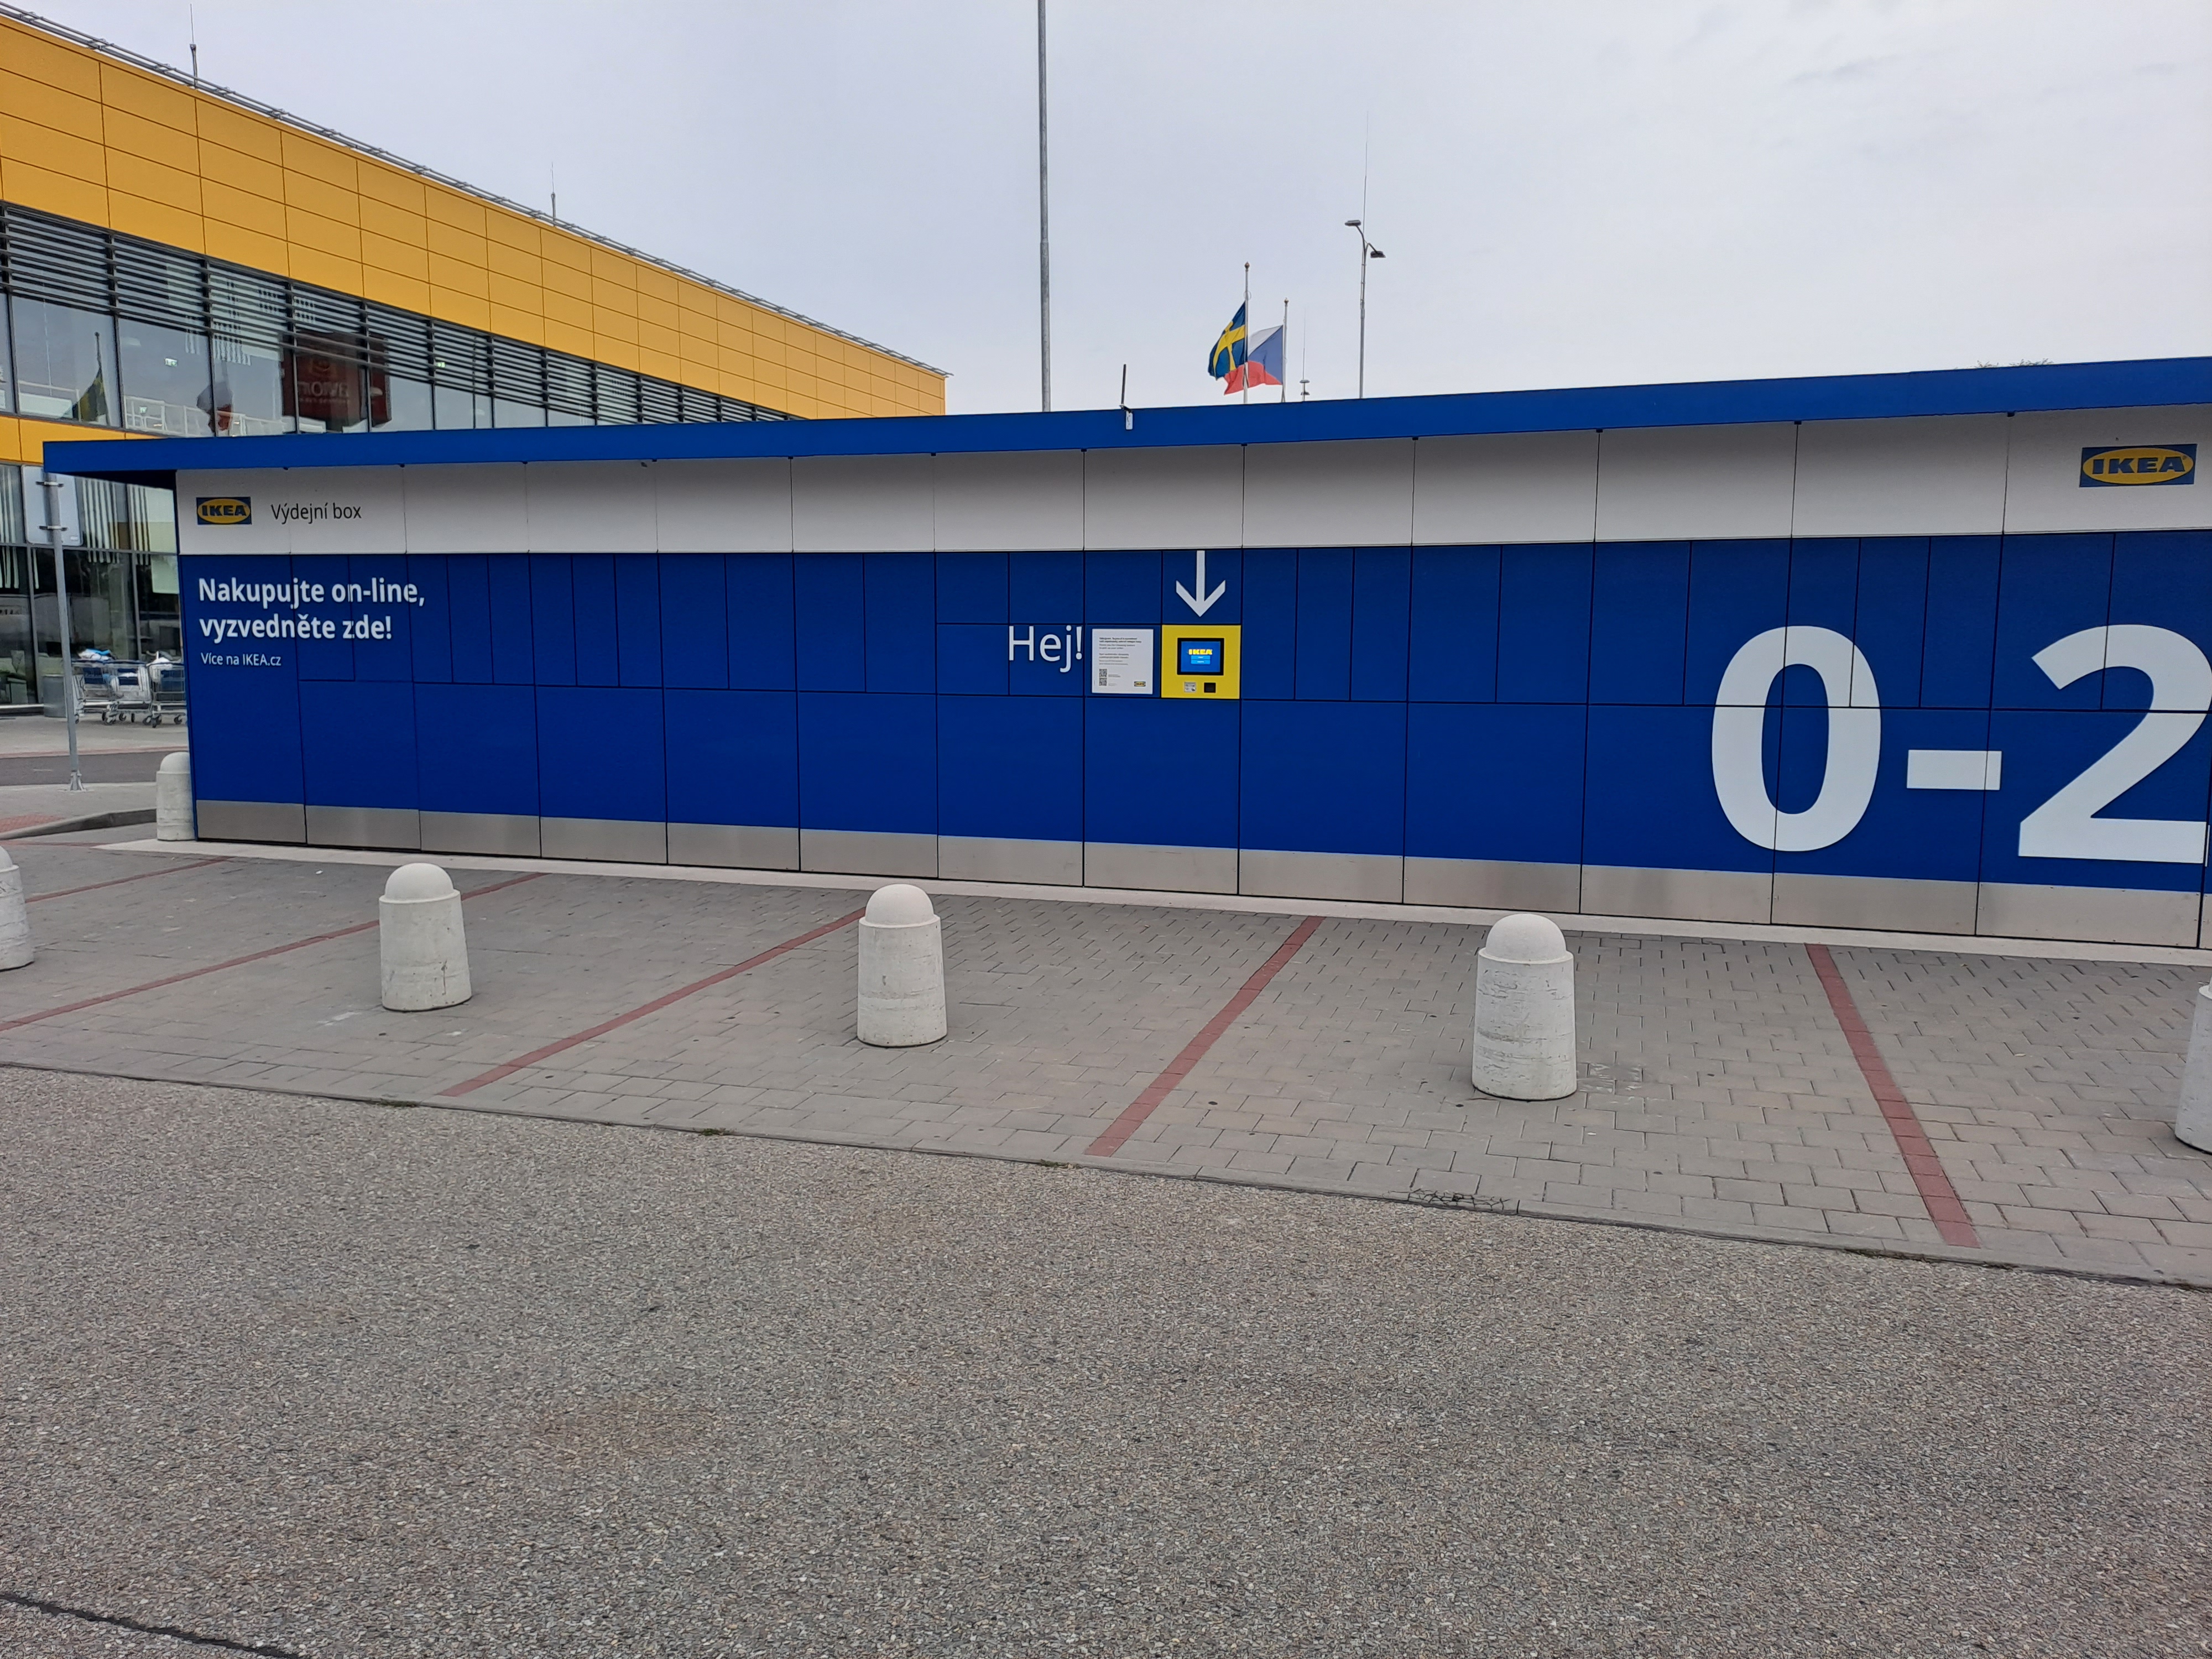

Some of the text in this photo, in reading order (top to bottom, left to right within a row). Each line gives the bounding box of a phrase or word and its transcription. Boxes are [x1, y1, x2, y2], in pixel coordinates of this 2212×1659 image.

[2092, 456, 2185, 474] IKEA
[201, 505, 247, 517] IKEA
[270, 502, 362, 525] Výdejní box
[199, 577, 425, 609] Nakupujte on-line,
[199, 613, 392, 644] vyzvedněte zde!
[201, 652, 281, 666] Více na IKEA.cz
[1009, 625, 1082, 673] Hej!
